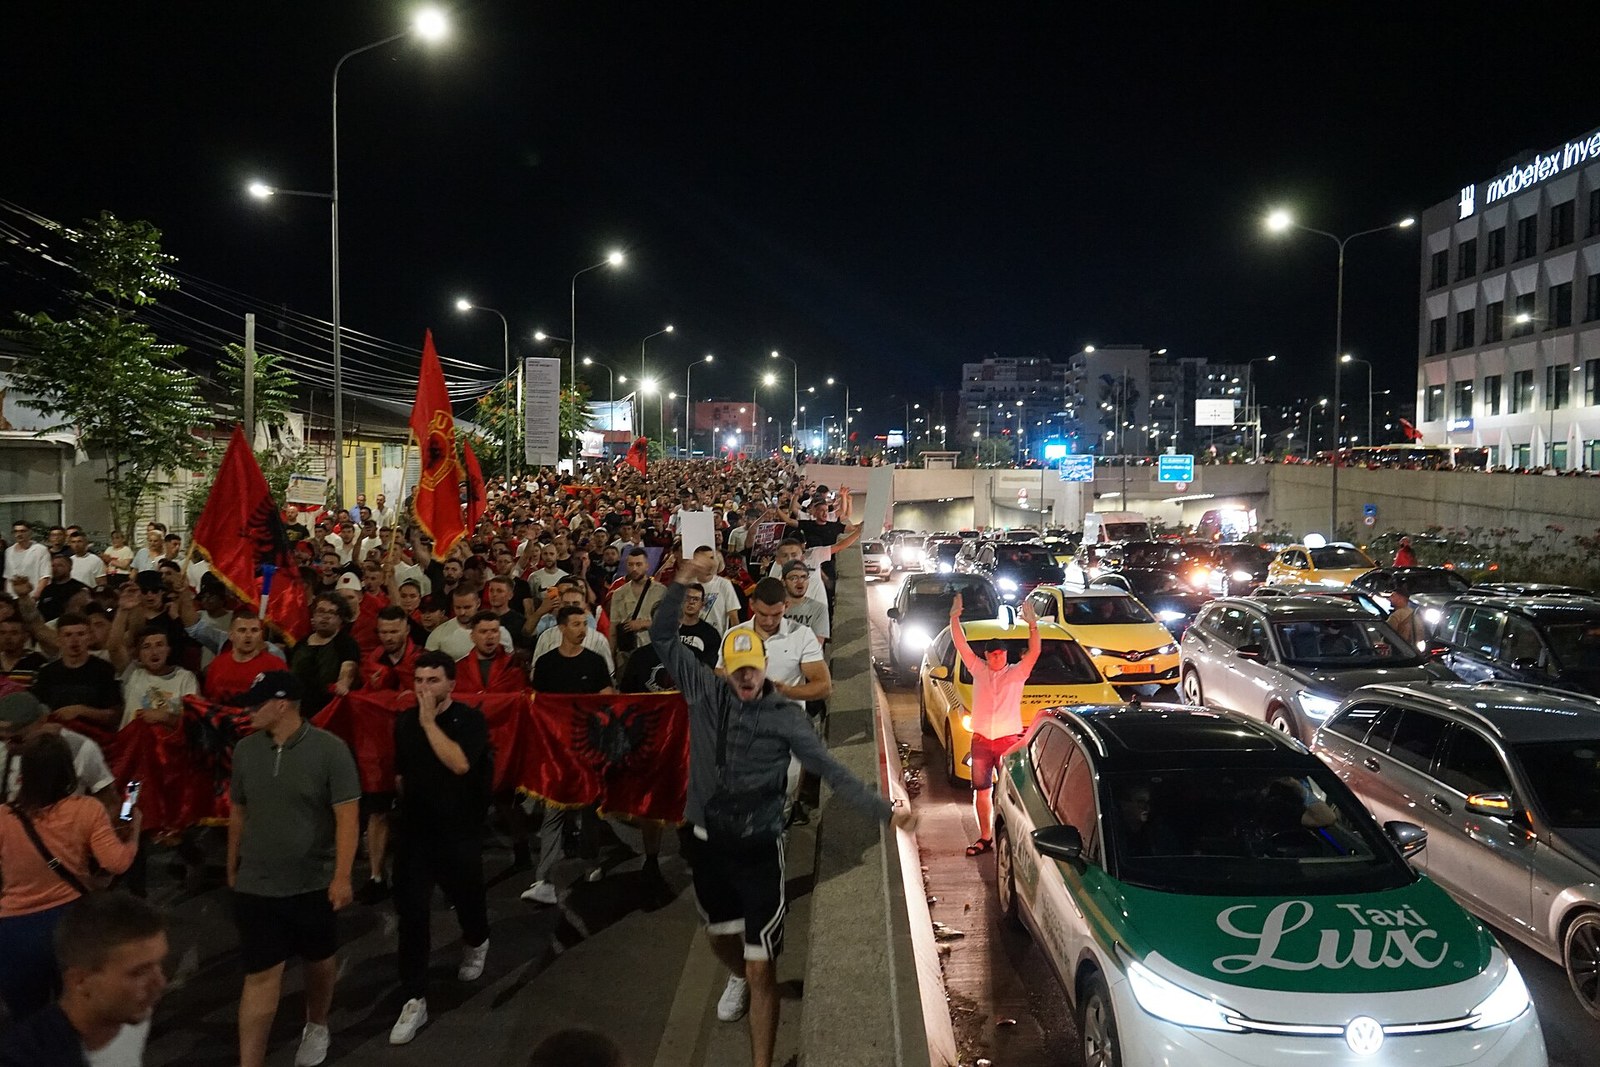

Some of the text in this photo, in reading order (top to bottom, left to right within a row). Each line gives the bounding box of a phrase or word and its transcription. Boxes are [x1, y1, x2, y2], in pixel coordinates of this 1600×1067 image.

[1486, 151, 1560, 204] mabetex
[1212, 900, 1449, 974] Lux
[1336, 903, 1428, 926] Taxi
